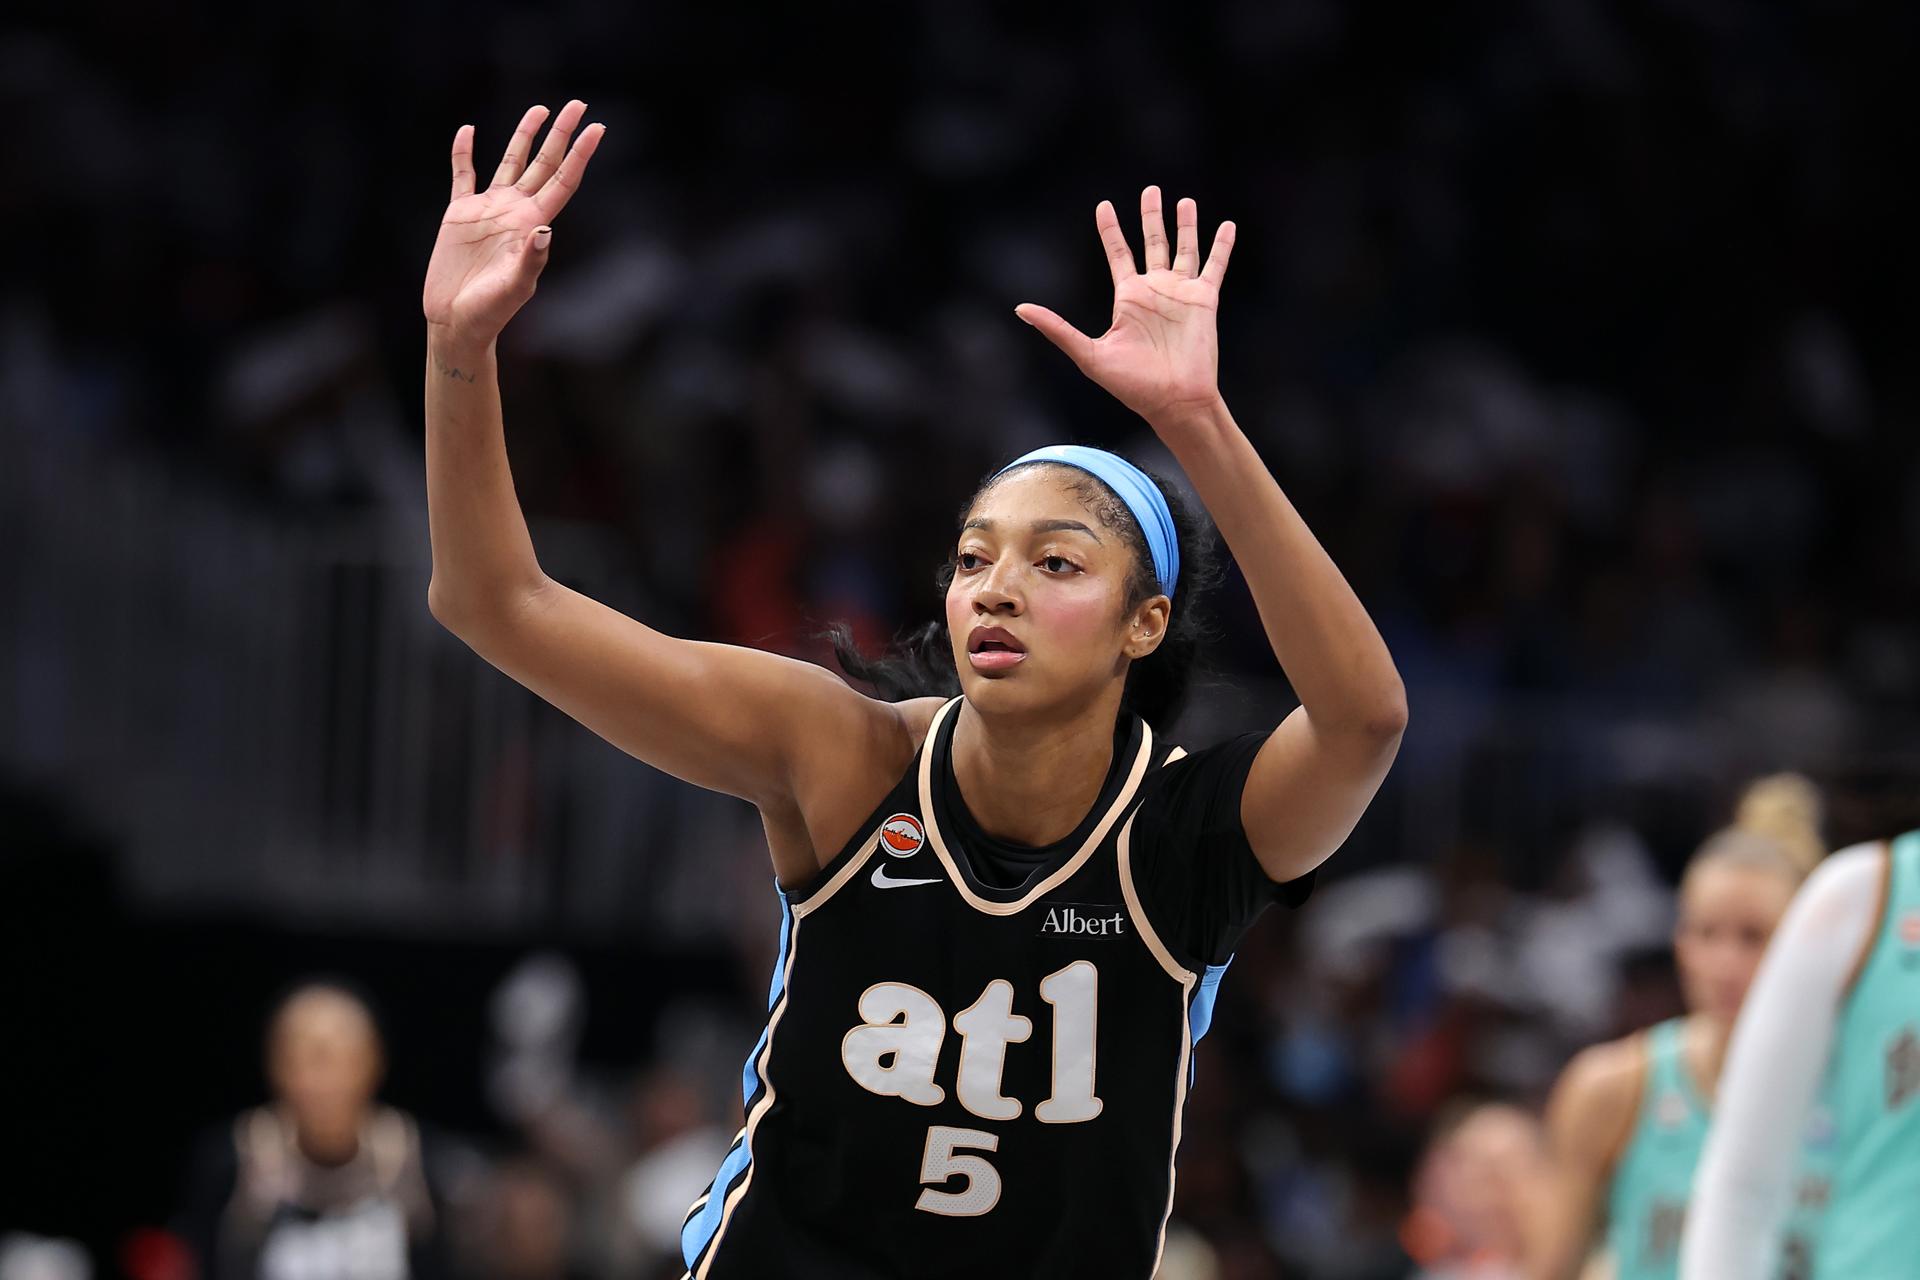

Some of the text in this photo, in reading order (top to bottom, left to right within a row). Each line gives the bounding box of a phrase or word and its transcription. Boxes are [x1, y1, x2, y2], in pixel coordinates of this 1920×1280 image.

[1041, 907, 1124, 935] Albert
[842, 960, 1103, 1123] atl
[915, 1126, 1002, 1216] 5
